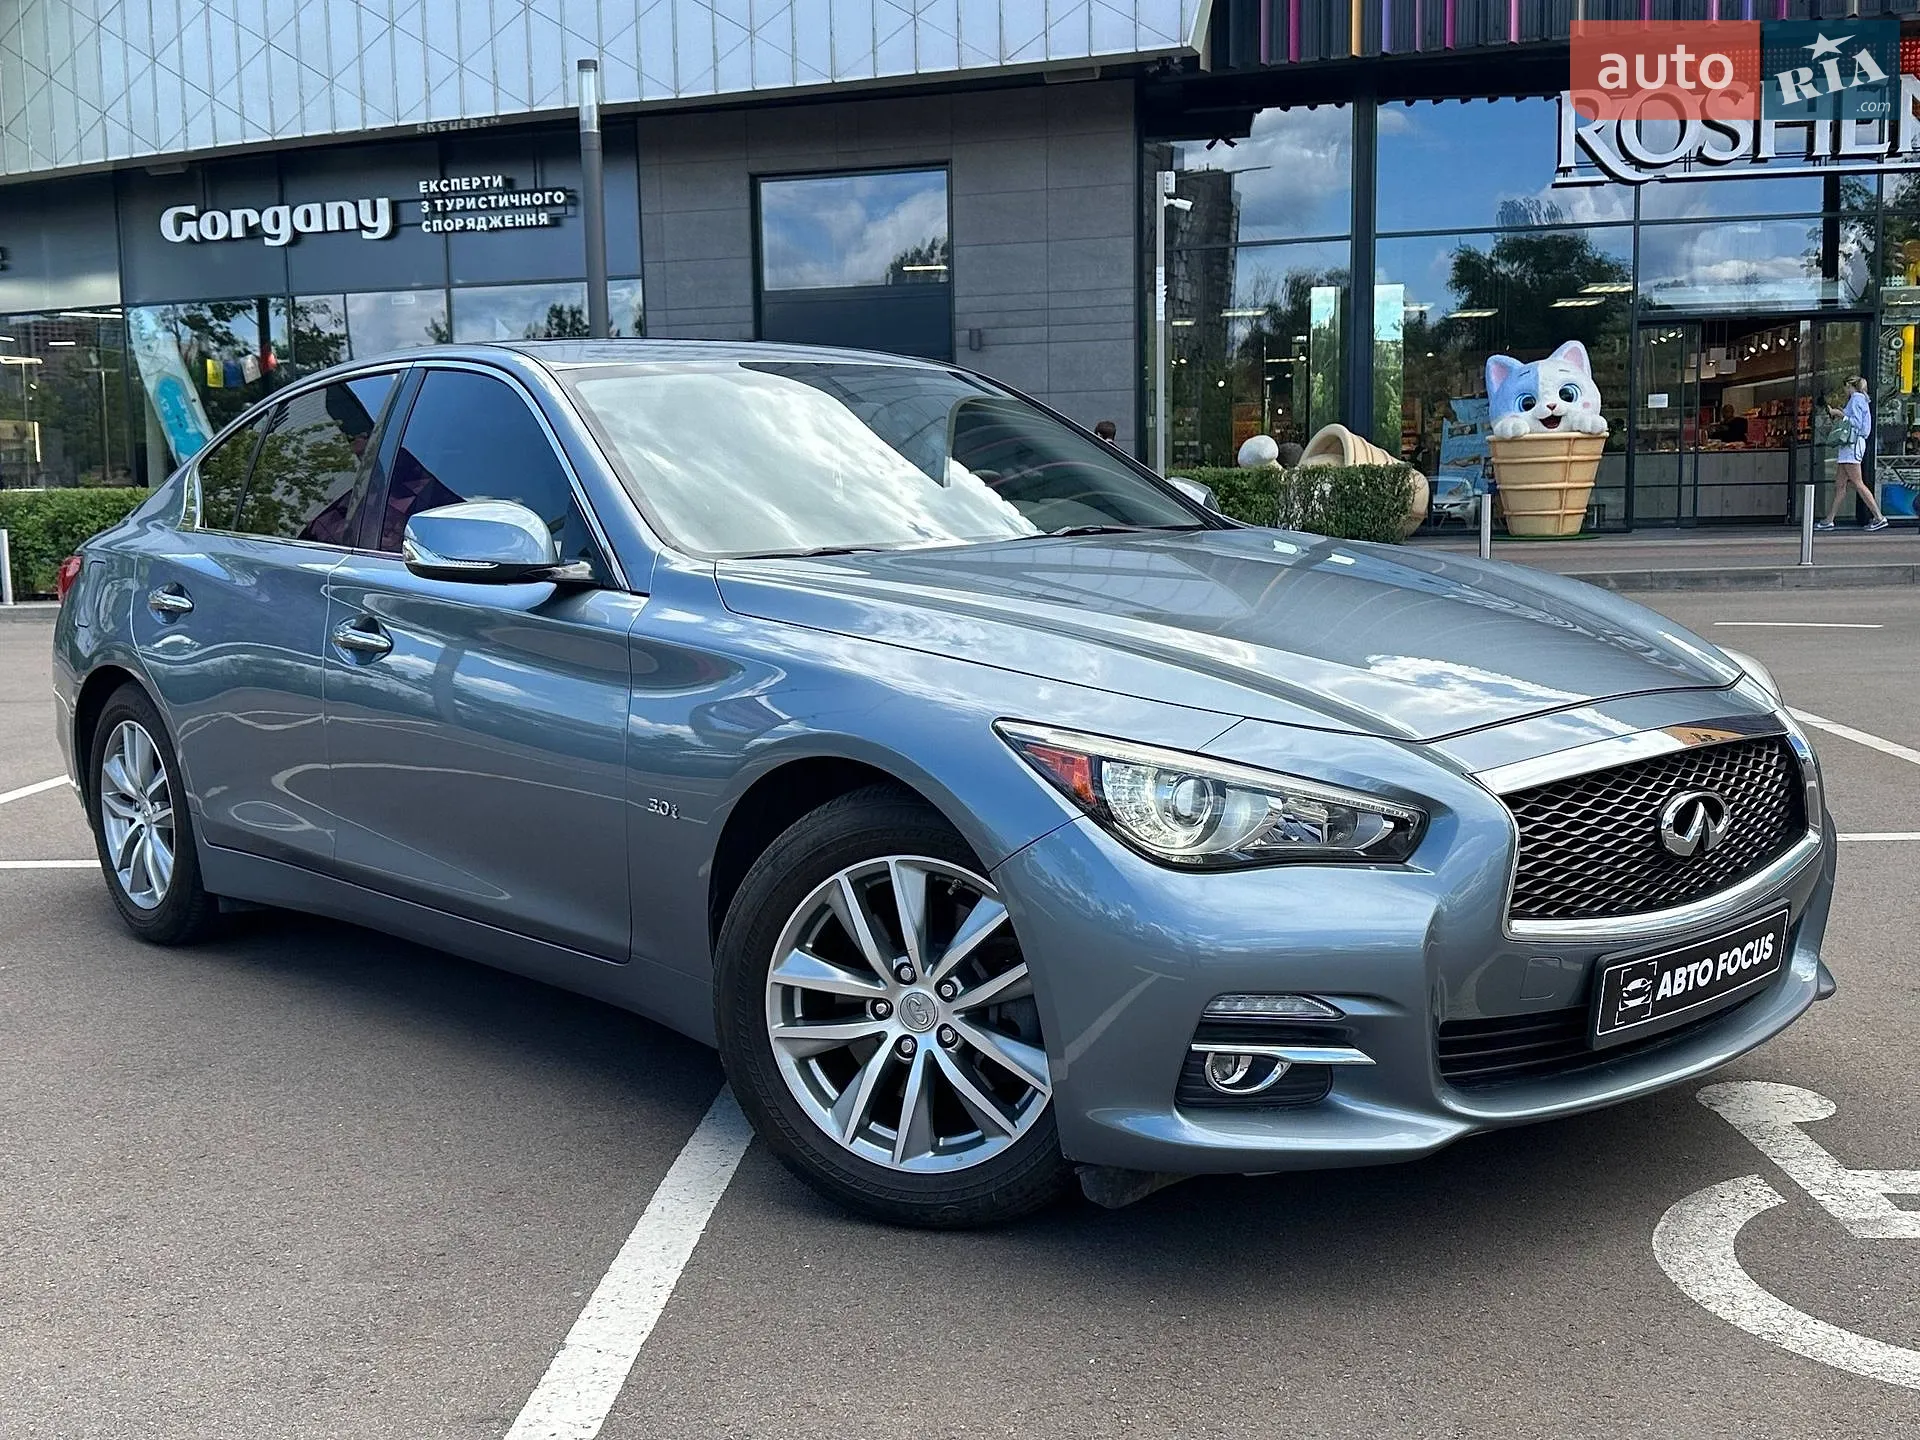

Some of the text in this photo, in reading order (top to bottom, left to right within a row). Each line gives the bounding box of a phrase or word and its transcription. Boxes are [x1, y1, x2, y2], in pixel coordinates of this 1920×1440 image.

[418, 175, 503, 194] ЕКСПЕРТИ
[434, 190, 565, 213] ТУРИСТИЧНОГО
[159, 197, 390, 247] Gorgany
[421, 212, 549, 233] СПОРЯДЖЕННЯ
[1715, 931, 1775, 982] FOCUS
